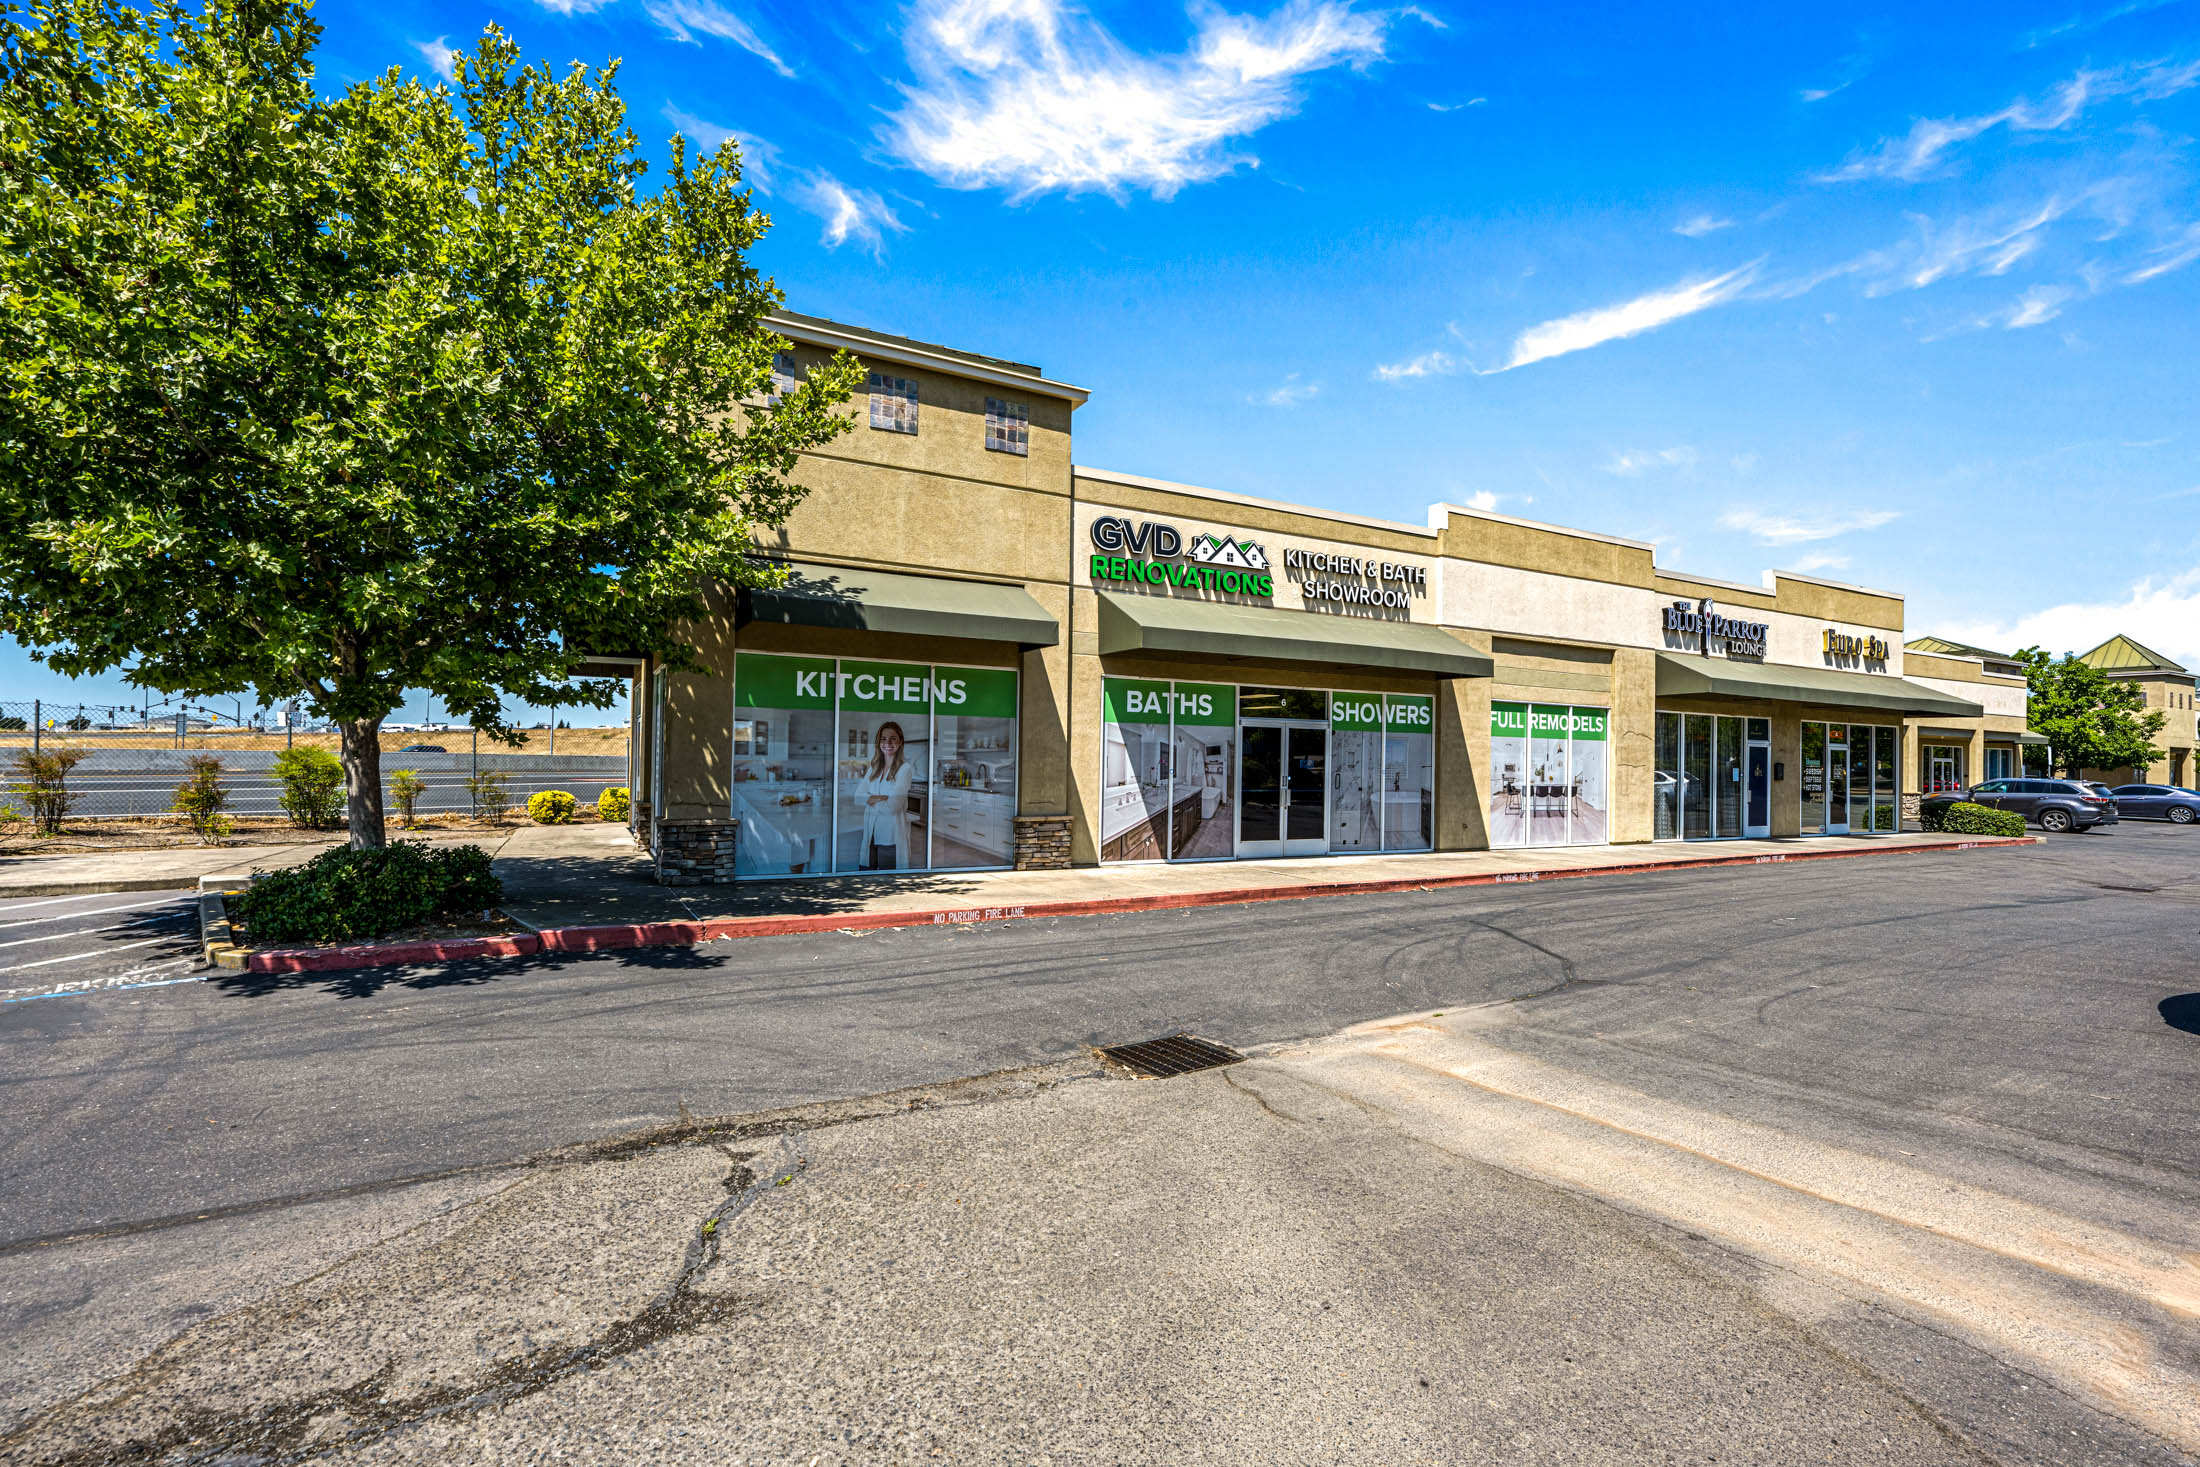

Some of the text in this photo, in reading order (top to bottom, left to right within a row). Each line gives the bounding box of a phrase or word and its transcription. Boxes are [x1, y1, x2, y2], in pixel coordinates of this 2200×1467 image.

[1092, 516, 1182, 558] GVD
[1091, 555, 1273, 597] RENOVATIONS
[1286, 550, 1426, 584] KITCHEN & BATH
[1304, 581, 1410, 609] SHOWROOM
[1679, 602, 1691, 611] THE
[1667, 608, 1769, 641] BLUE PARROT
[1731, 641, 1767, 656] LOUNGE
[796, 670, 967, 704] KITCHENS
[1126, 690, 1213, 716] BATHS
[1281, 699, 1287, 707] 6
[1332, 701, 1430, 725] SHOWERS
[1490, 711, 1525, 729] FULL
[1530, 713, 1604, 732] REMODELS
[934, 907, 1025, 924] NO PARKING FIRE LANE
